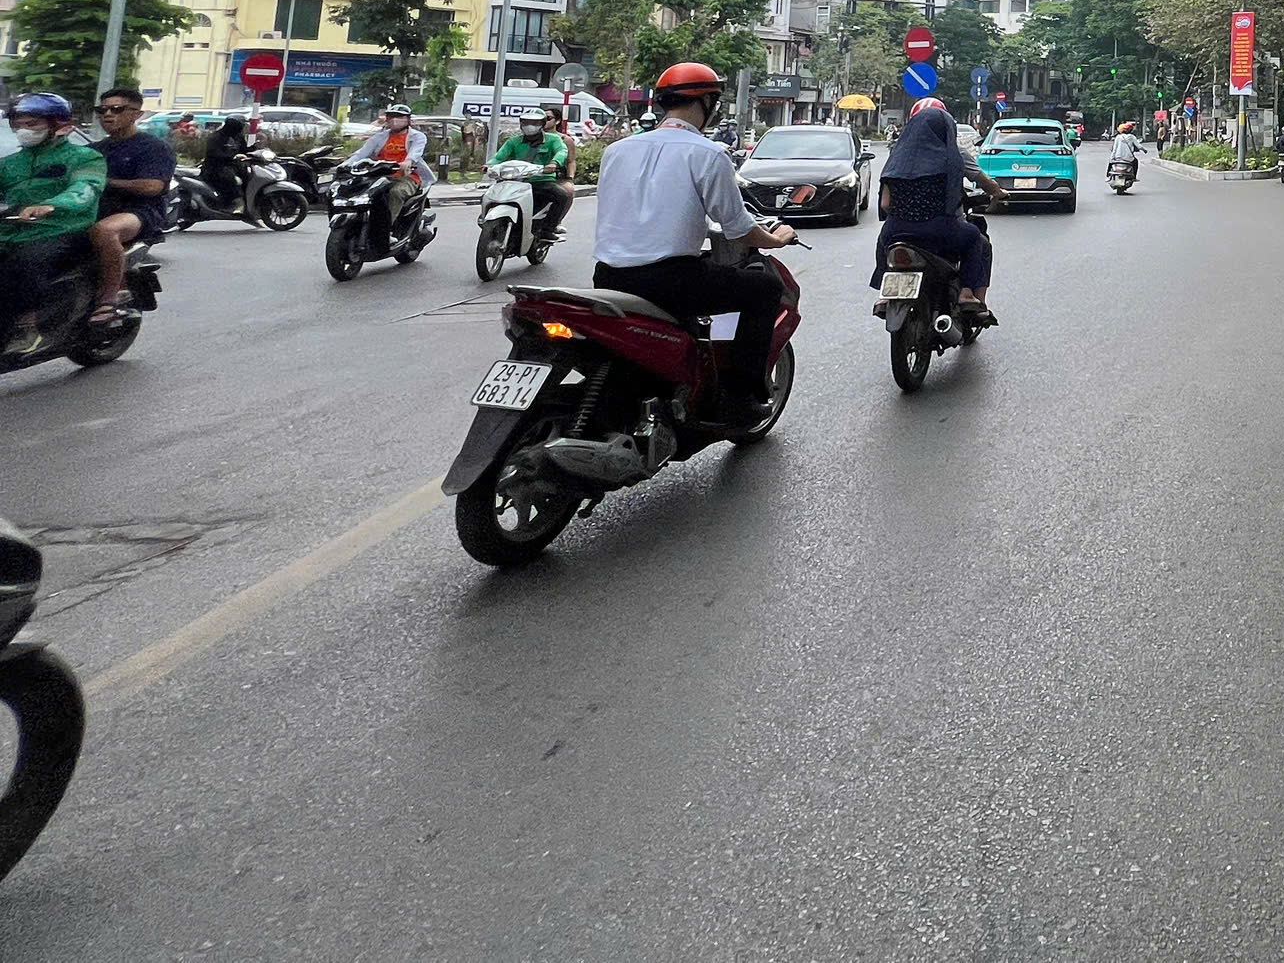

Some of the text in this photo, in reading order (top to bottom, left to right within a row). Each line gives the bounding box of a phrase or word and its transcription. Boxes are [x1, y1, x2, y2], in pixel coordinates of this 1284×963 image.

[466, 104, 531, 116] POIC
[493, 364, 541, 385] 29-P1
[476, 383, 532, 407] 683.14
